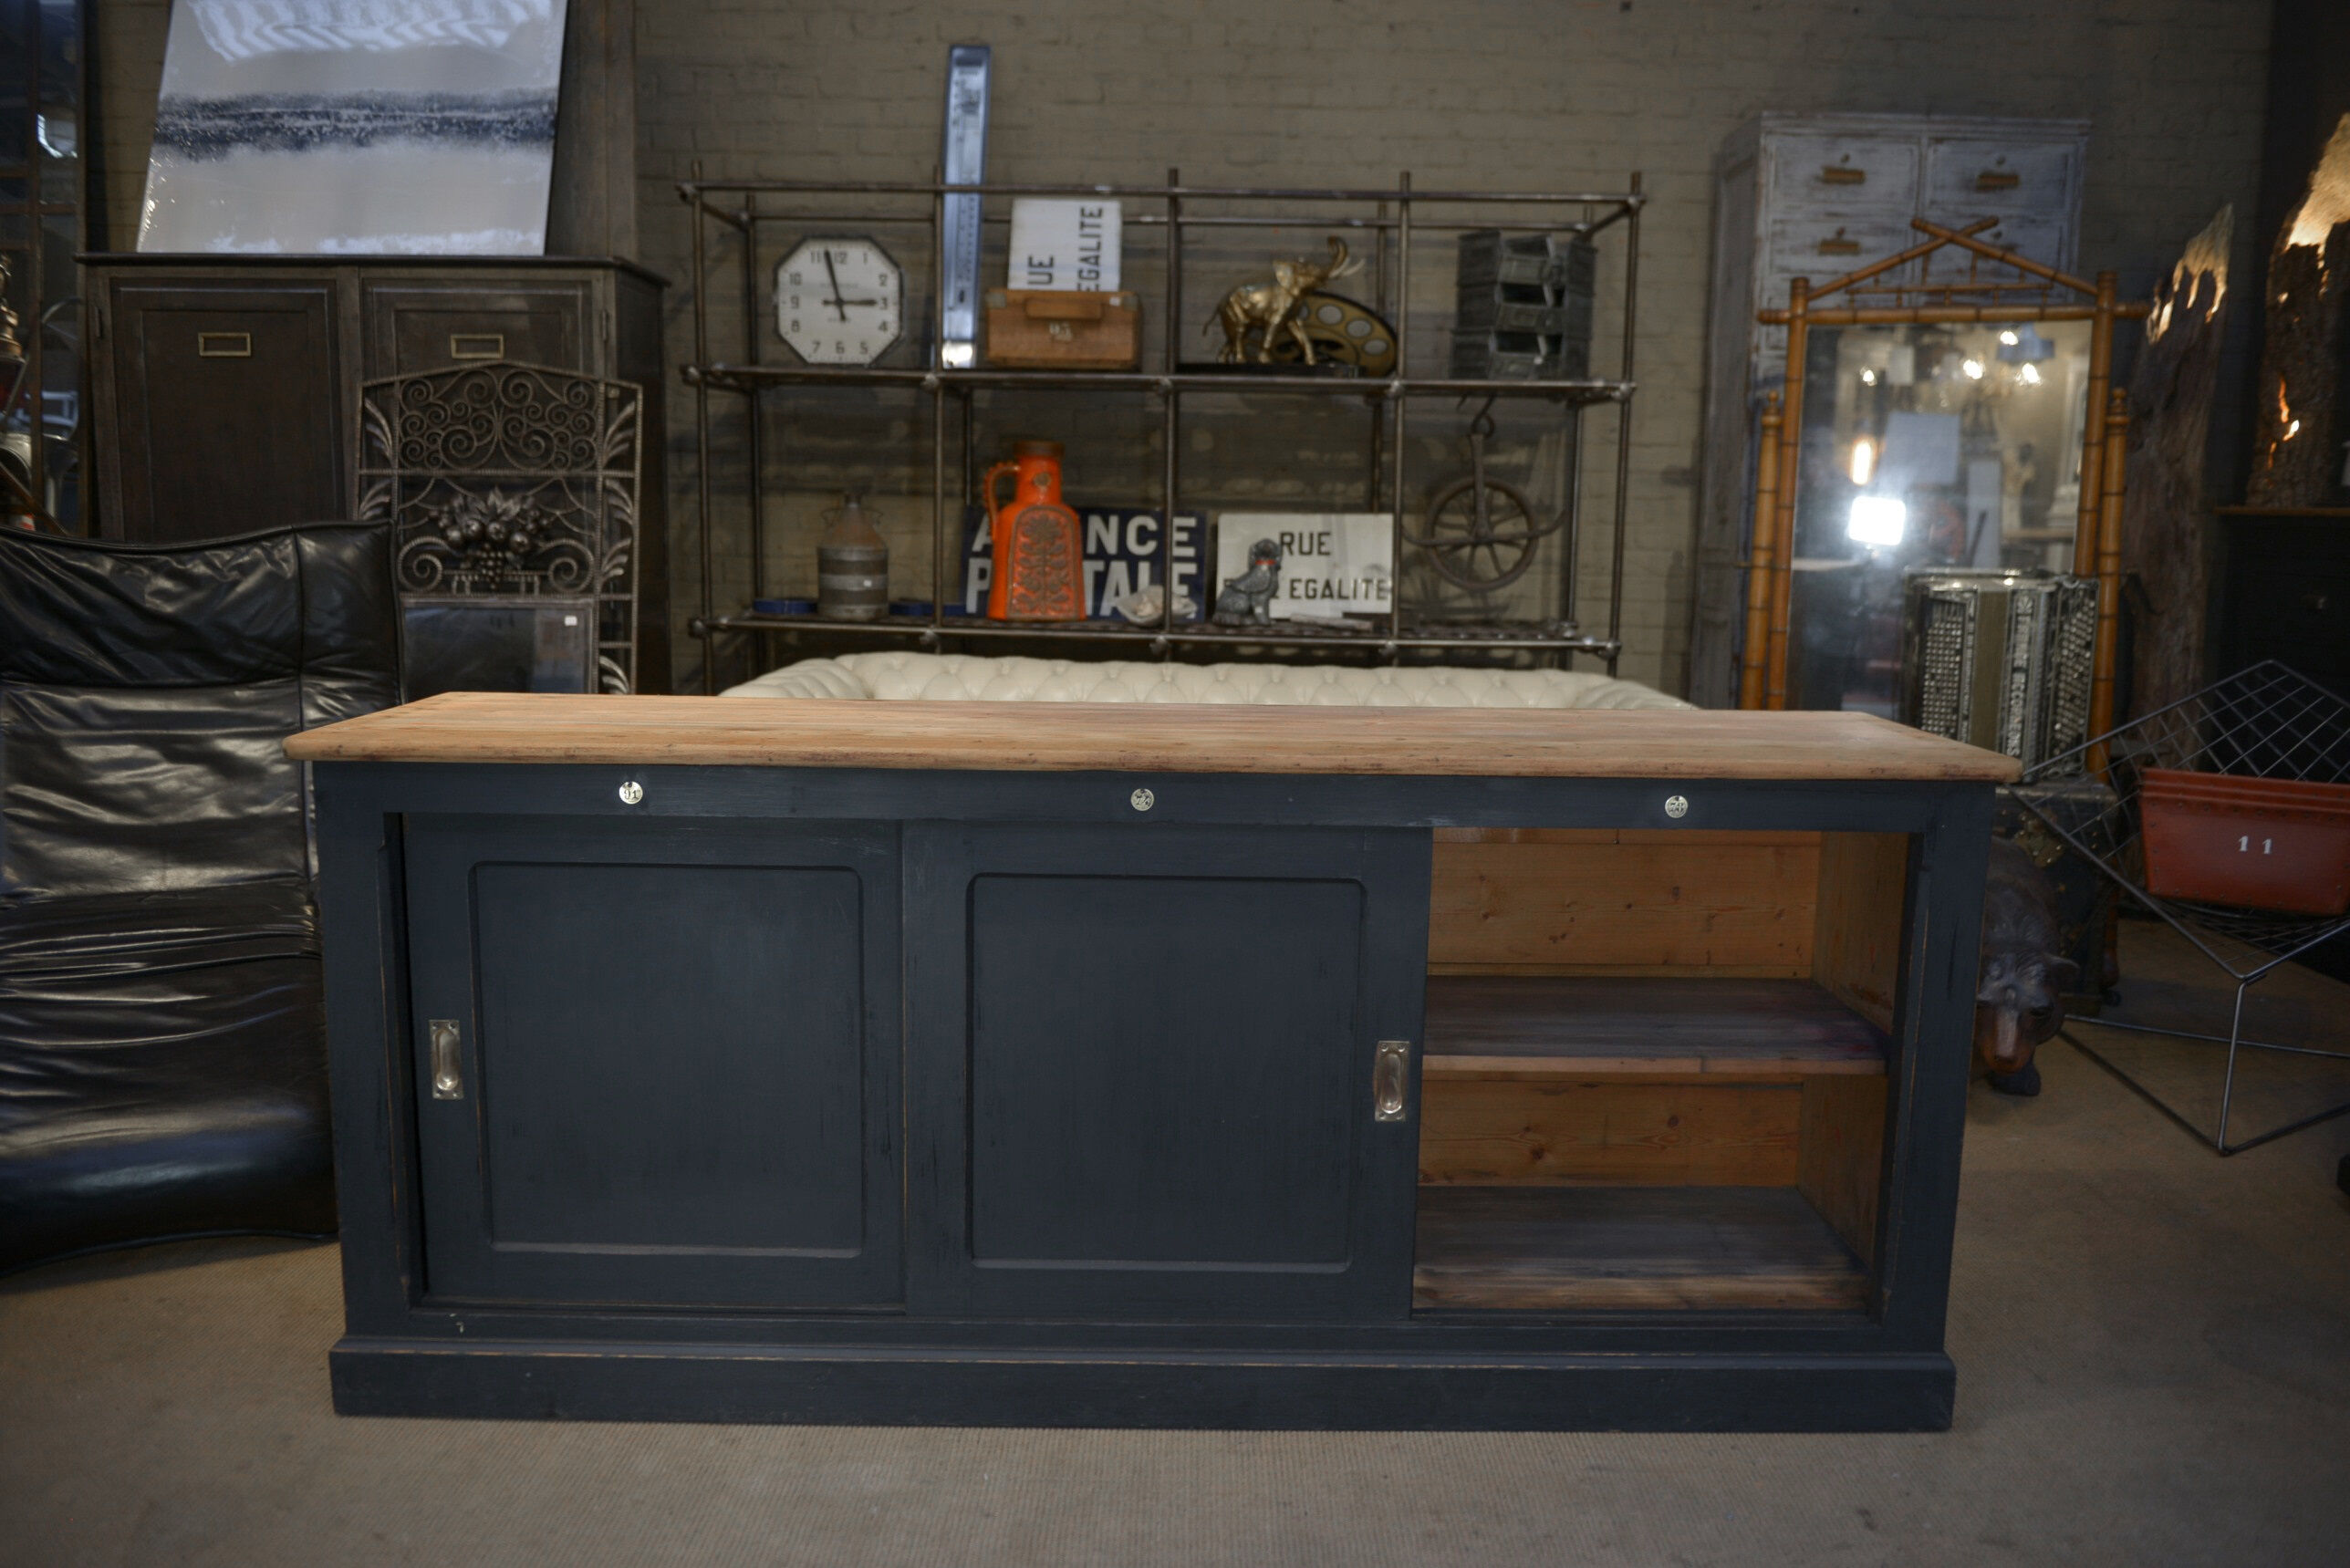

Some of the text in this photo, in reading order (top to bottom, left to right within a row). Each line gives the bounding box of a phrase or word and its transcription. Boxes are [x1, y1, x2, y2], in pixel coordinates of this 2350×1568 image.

[1077, 207, 1102, 291] EGALITE
[834, 251, 847, 265] 12
[1027, 254, 1054, 285] UE
[879, 274, 888, 286] 2
[879, 320, 889, 332] 4
[812, 340, 821, 353] 7
[835, 340, 845, 354] 6
[860, 341, 868, 354] 5
[972, 512, 1197, 557] ANCE
[1280, 532, 1331, 556] RUE
[1289, 578, 1388, 599] EGALITE
